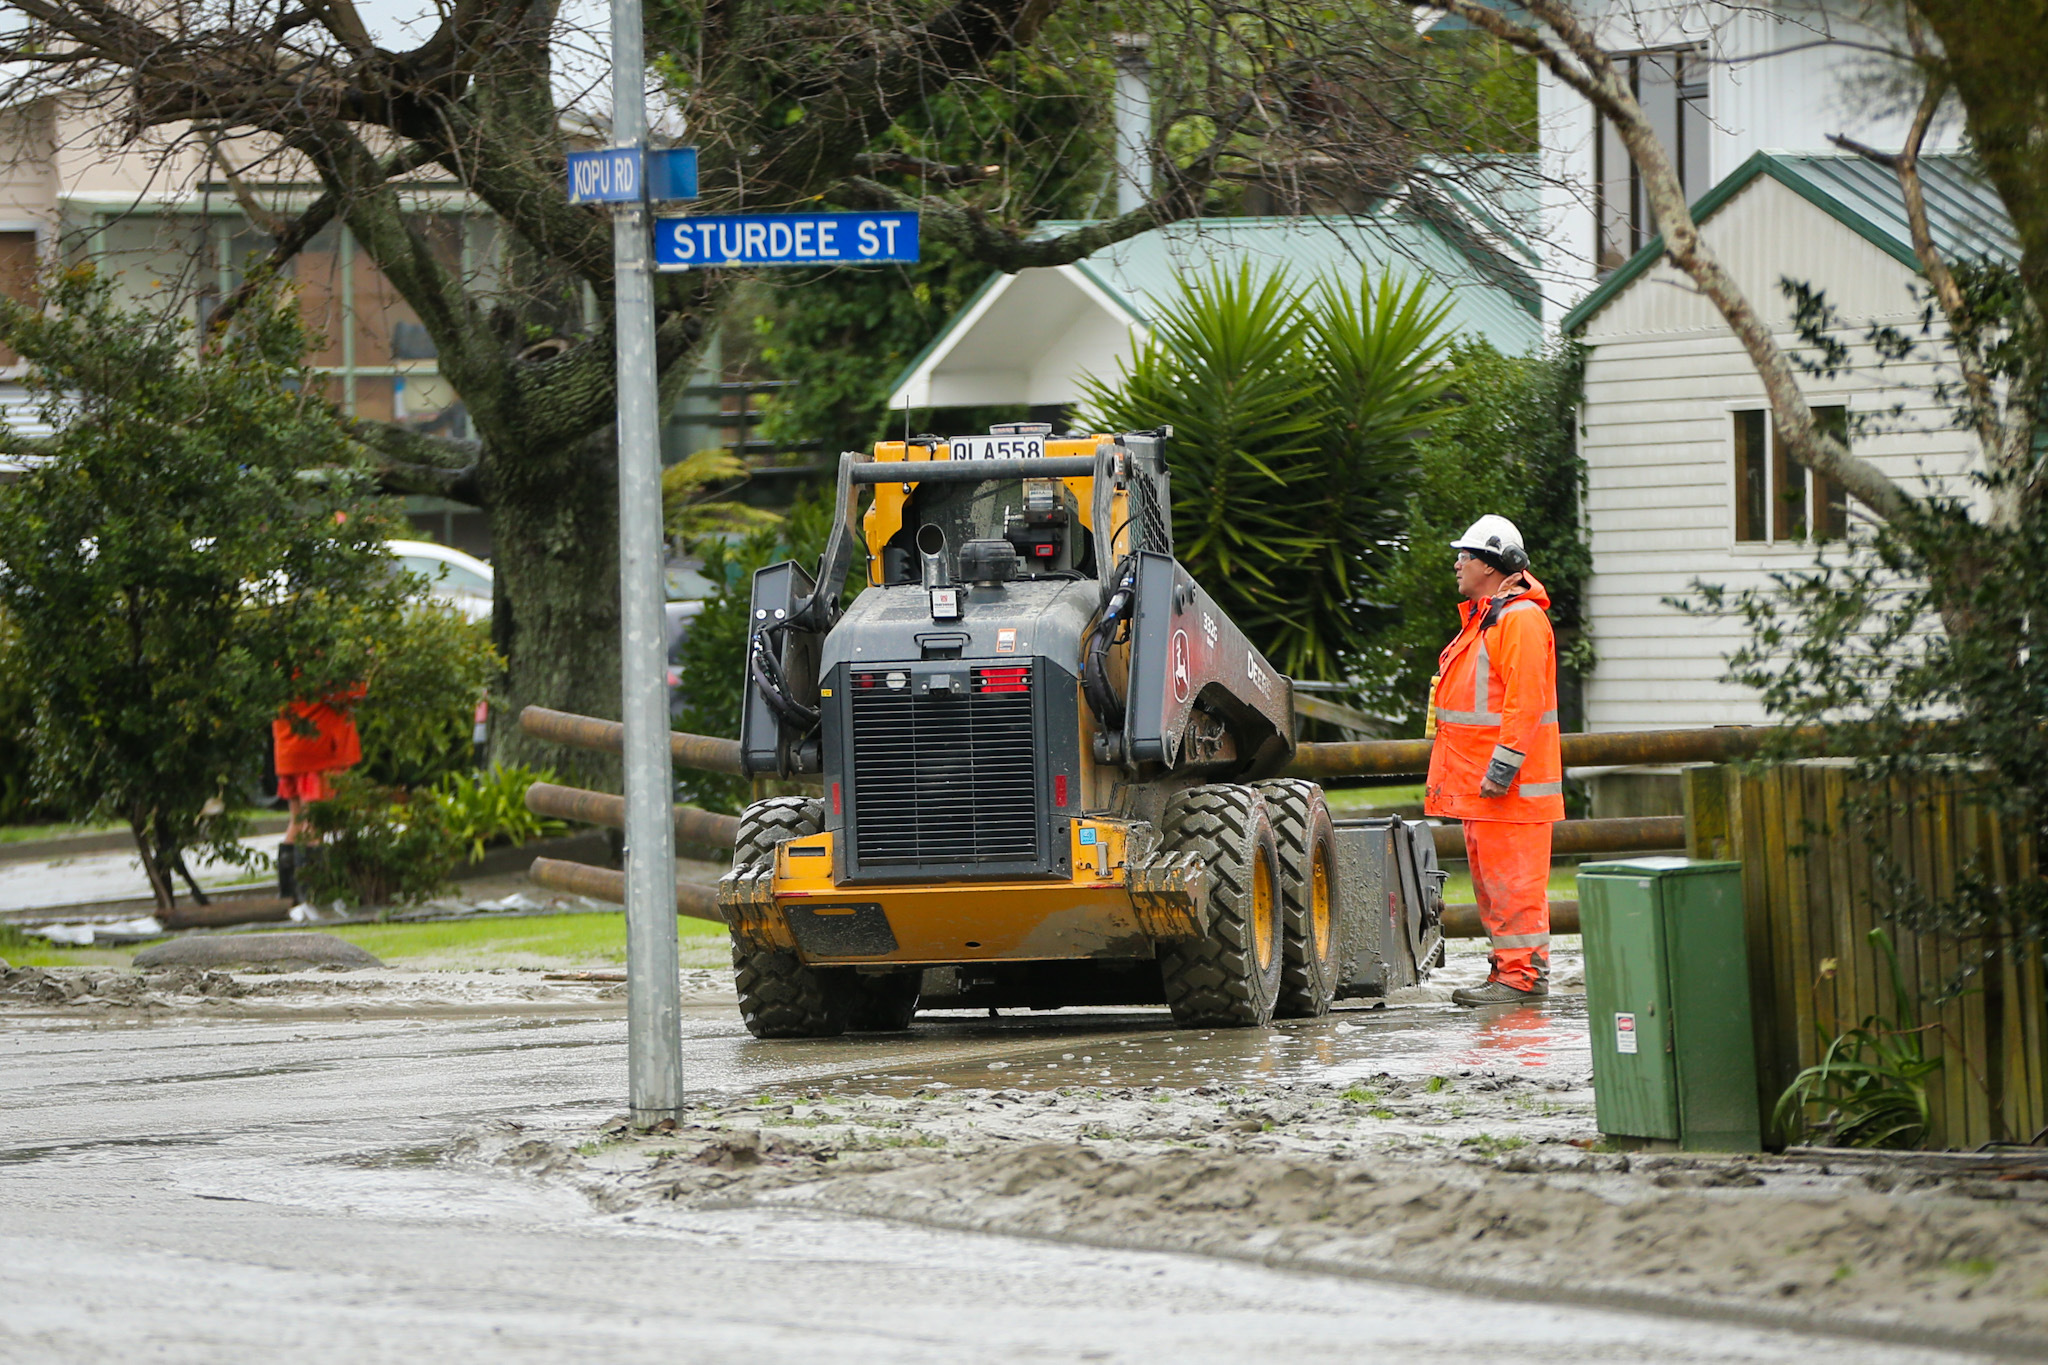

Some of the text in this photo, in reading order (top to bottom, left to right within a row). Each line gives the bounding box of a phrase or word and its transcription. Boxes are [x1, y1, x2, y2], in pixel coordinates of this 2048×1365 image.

[573, 157, 634, 195] KOPU RD
[673, 220, 901, 259] STURDEE ST
